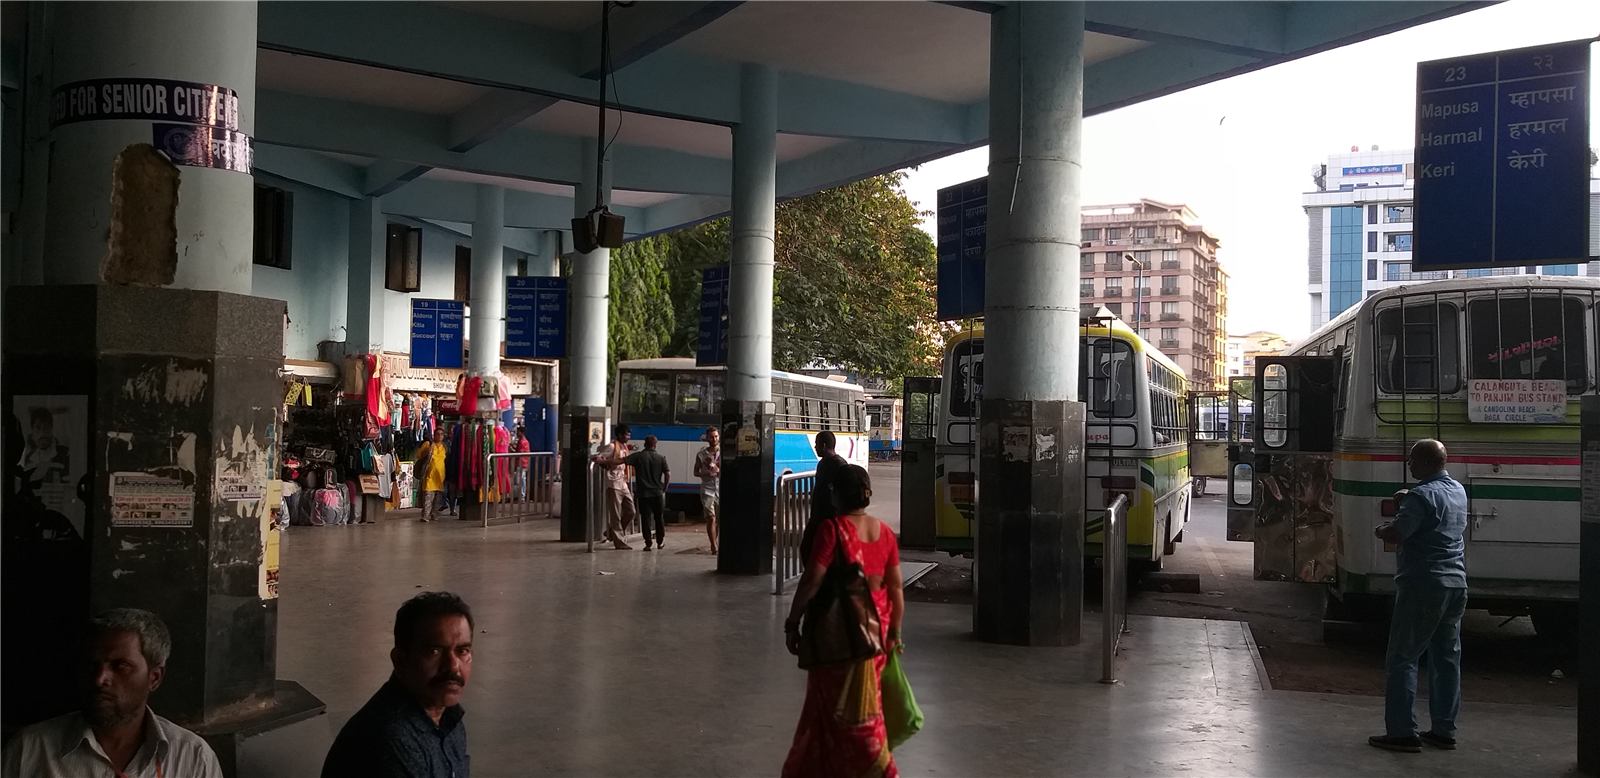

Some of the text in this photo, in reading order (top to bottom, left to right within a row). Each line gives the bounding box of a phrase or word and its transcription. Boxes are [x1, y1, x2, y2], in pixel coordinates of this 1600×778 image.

[1532, 54, 1554, 71] २३
[1444, 66, 1467, 83] 23
[70, 84, 98, 118] FOR
[102, 83, 168, 116] SENIOR
[1508, 86, 1577, 108] म्हापसा
[1421, 102, 1480, 119] Mapusa
[1420, 127, 1483, 147] Harmal
[1507, 118, 1569, 139] हरमल
[1507, 148, 1548, 170] केरी
[1420, 162, 1455, 179] Keri
[516, 279, 526, 287] 20
[1474, 381, 1528, 392] CALANGUTE
[1470, 392, 1565, 404] TO PANJIM BUS STAND
